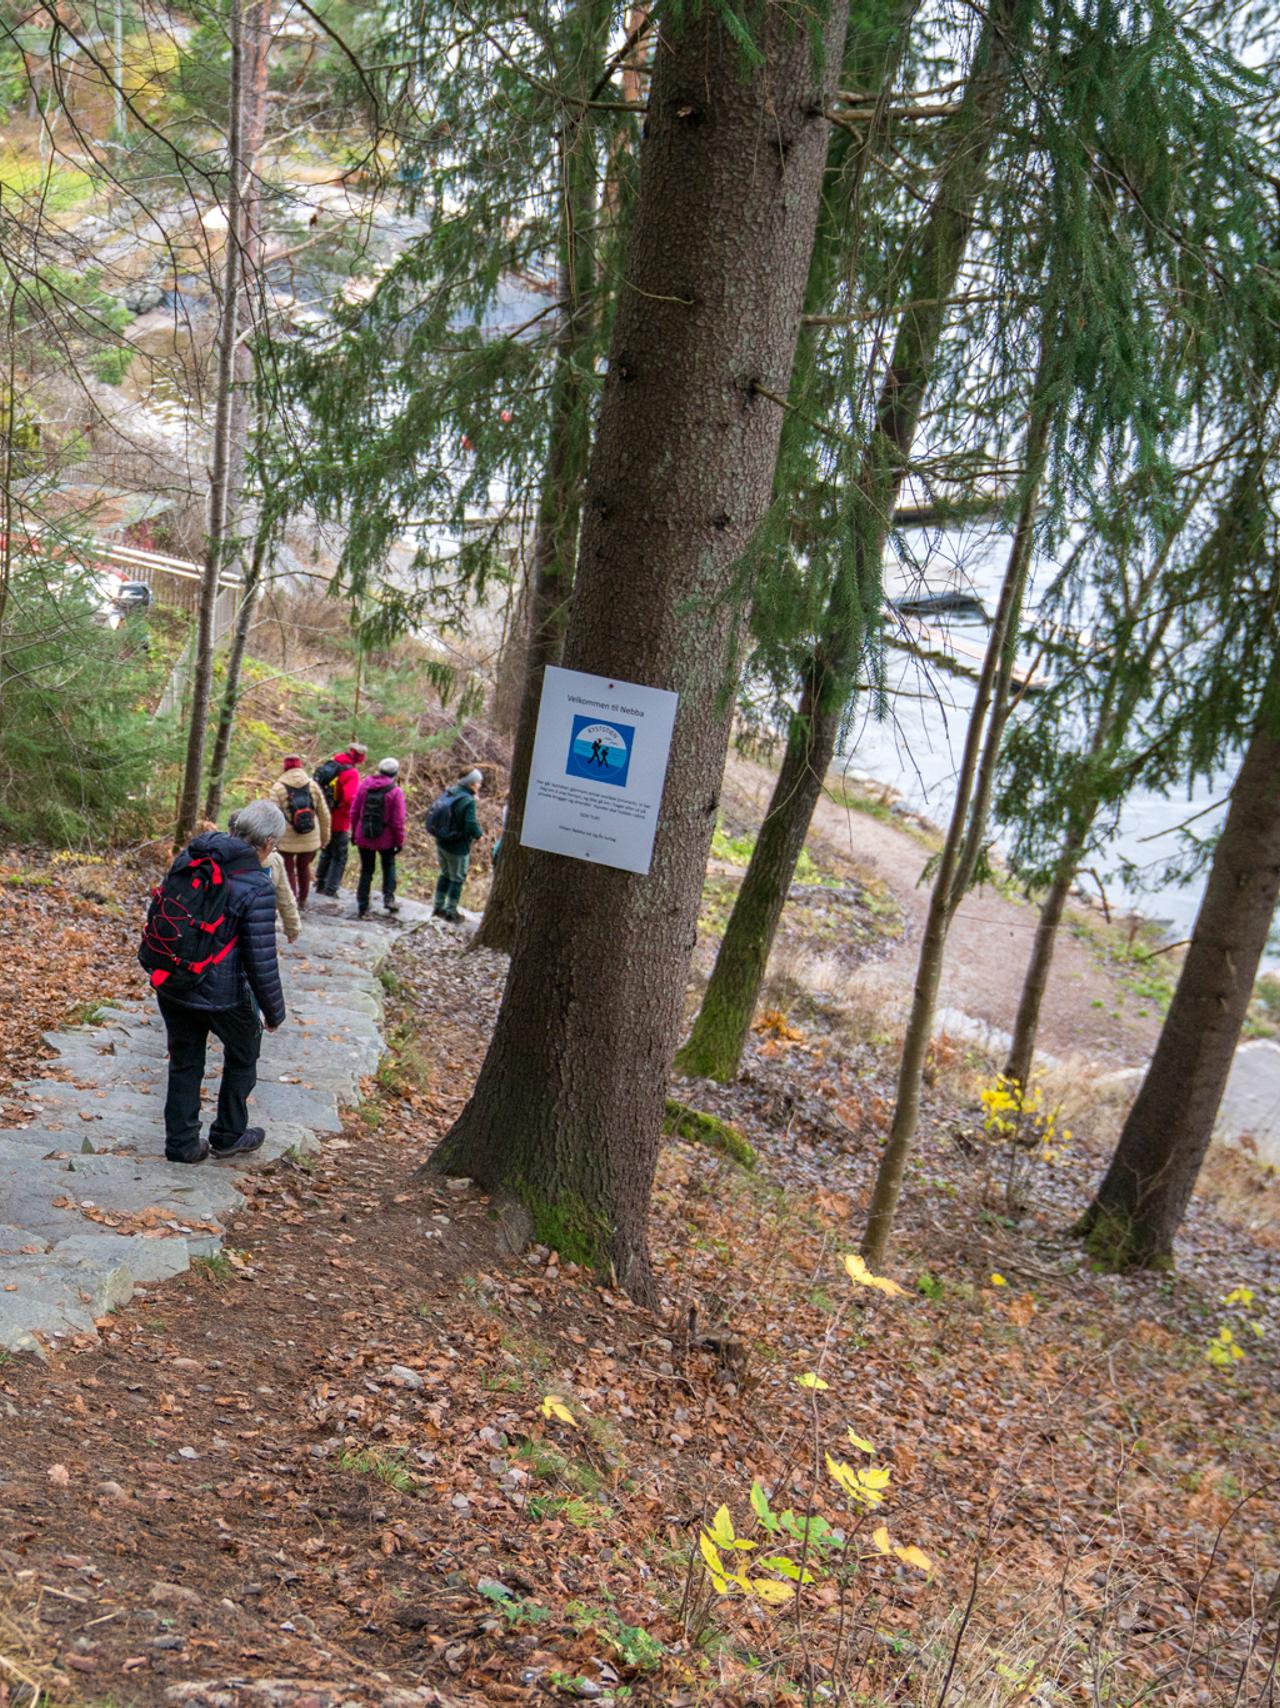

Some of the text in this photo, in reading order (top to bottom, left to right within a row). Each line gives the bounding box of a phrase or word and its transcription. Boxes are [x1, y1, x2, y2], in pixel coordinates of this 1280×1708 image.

[567, 695, 645, 718] Velkommen til Nebba
[588, 726, 618, 738] KYSTSTIEN
